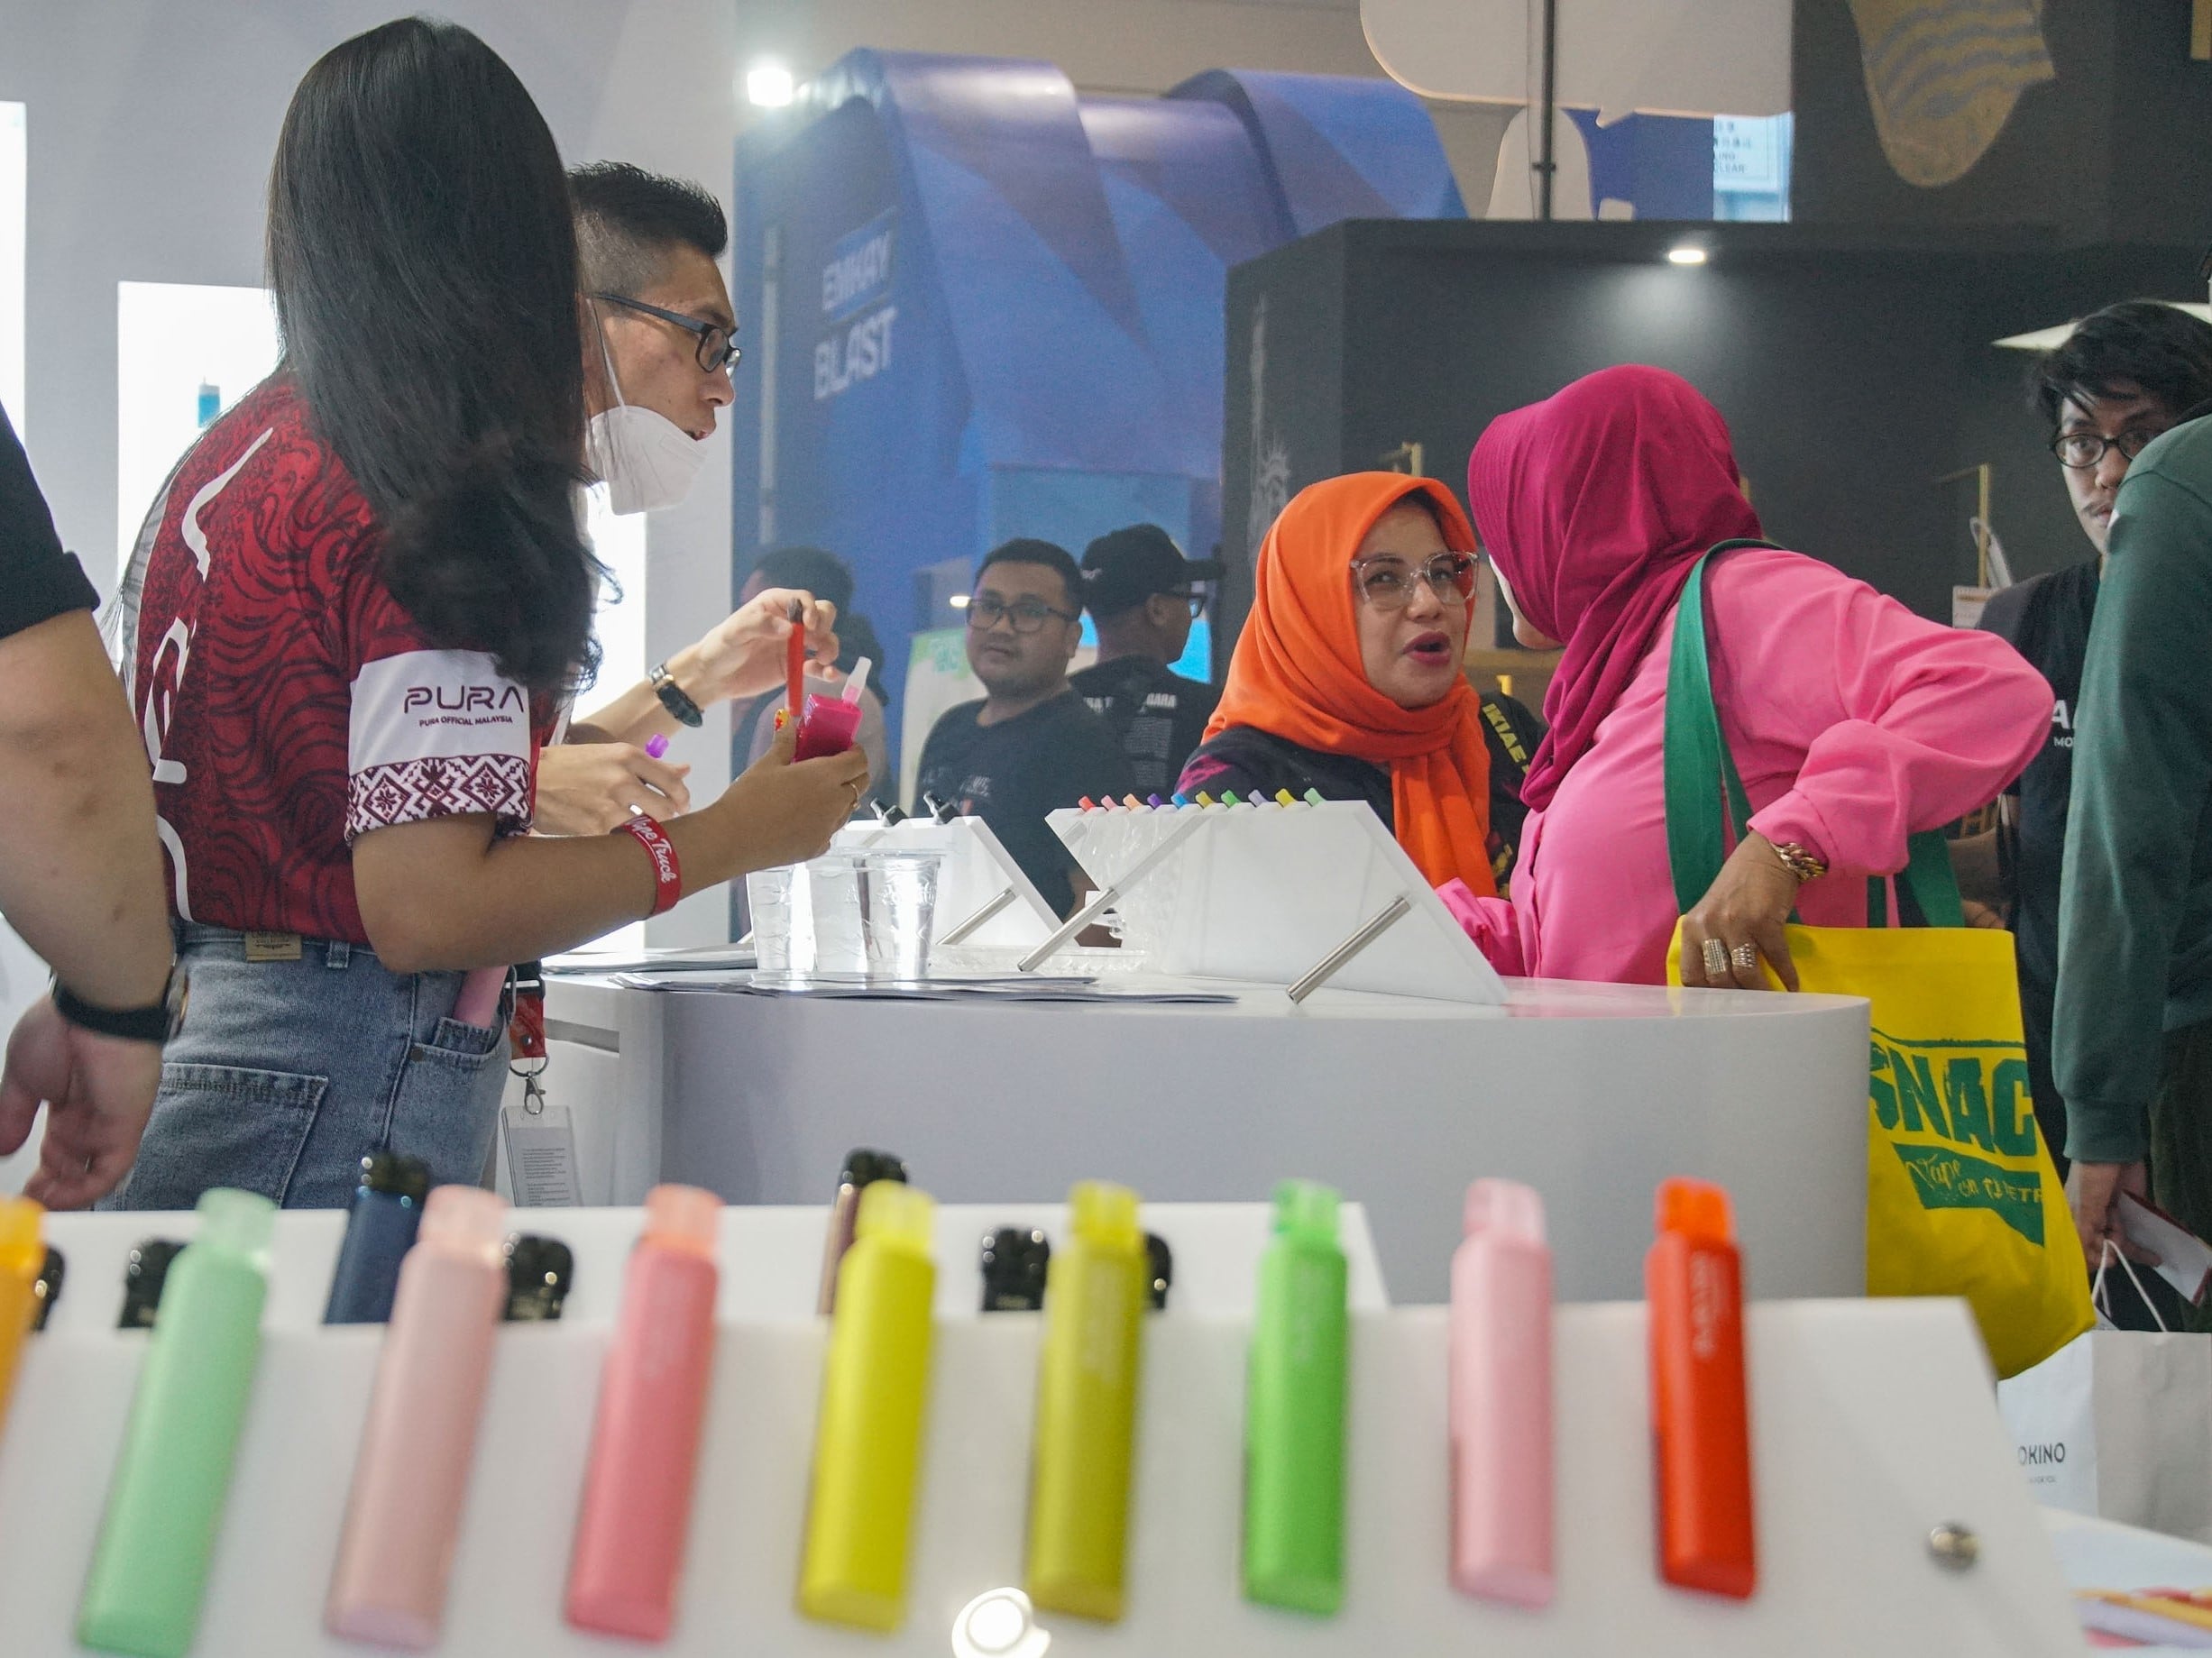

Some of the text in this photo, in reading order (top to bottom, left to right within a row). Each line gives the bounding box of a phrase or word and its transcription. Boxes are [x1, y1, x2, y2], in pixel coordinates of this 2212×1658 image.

[814, 307, 897, 398] BLAST
[404, 685, 524, 713] PURA
[419, 715, 513, 727] PURA OFFICIAL MALAYSIA
[651, 838, 676, 883] Truck
